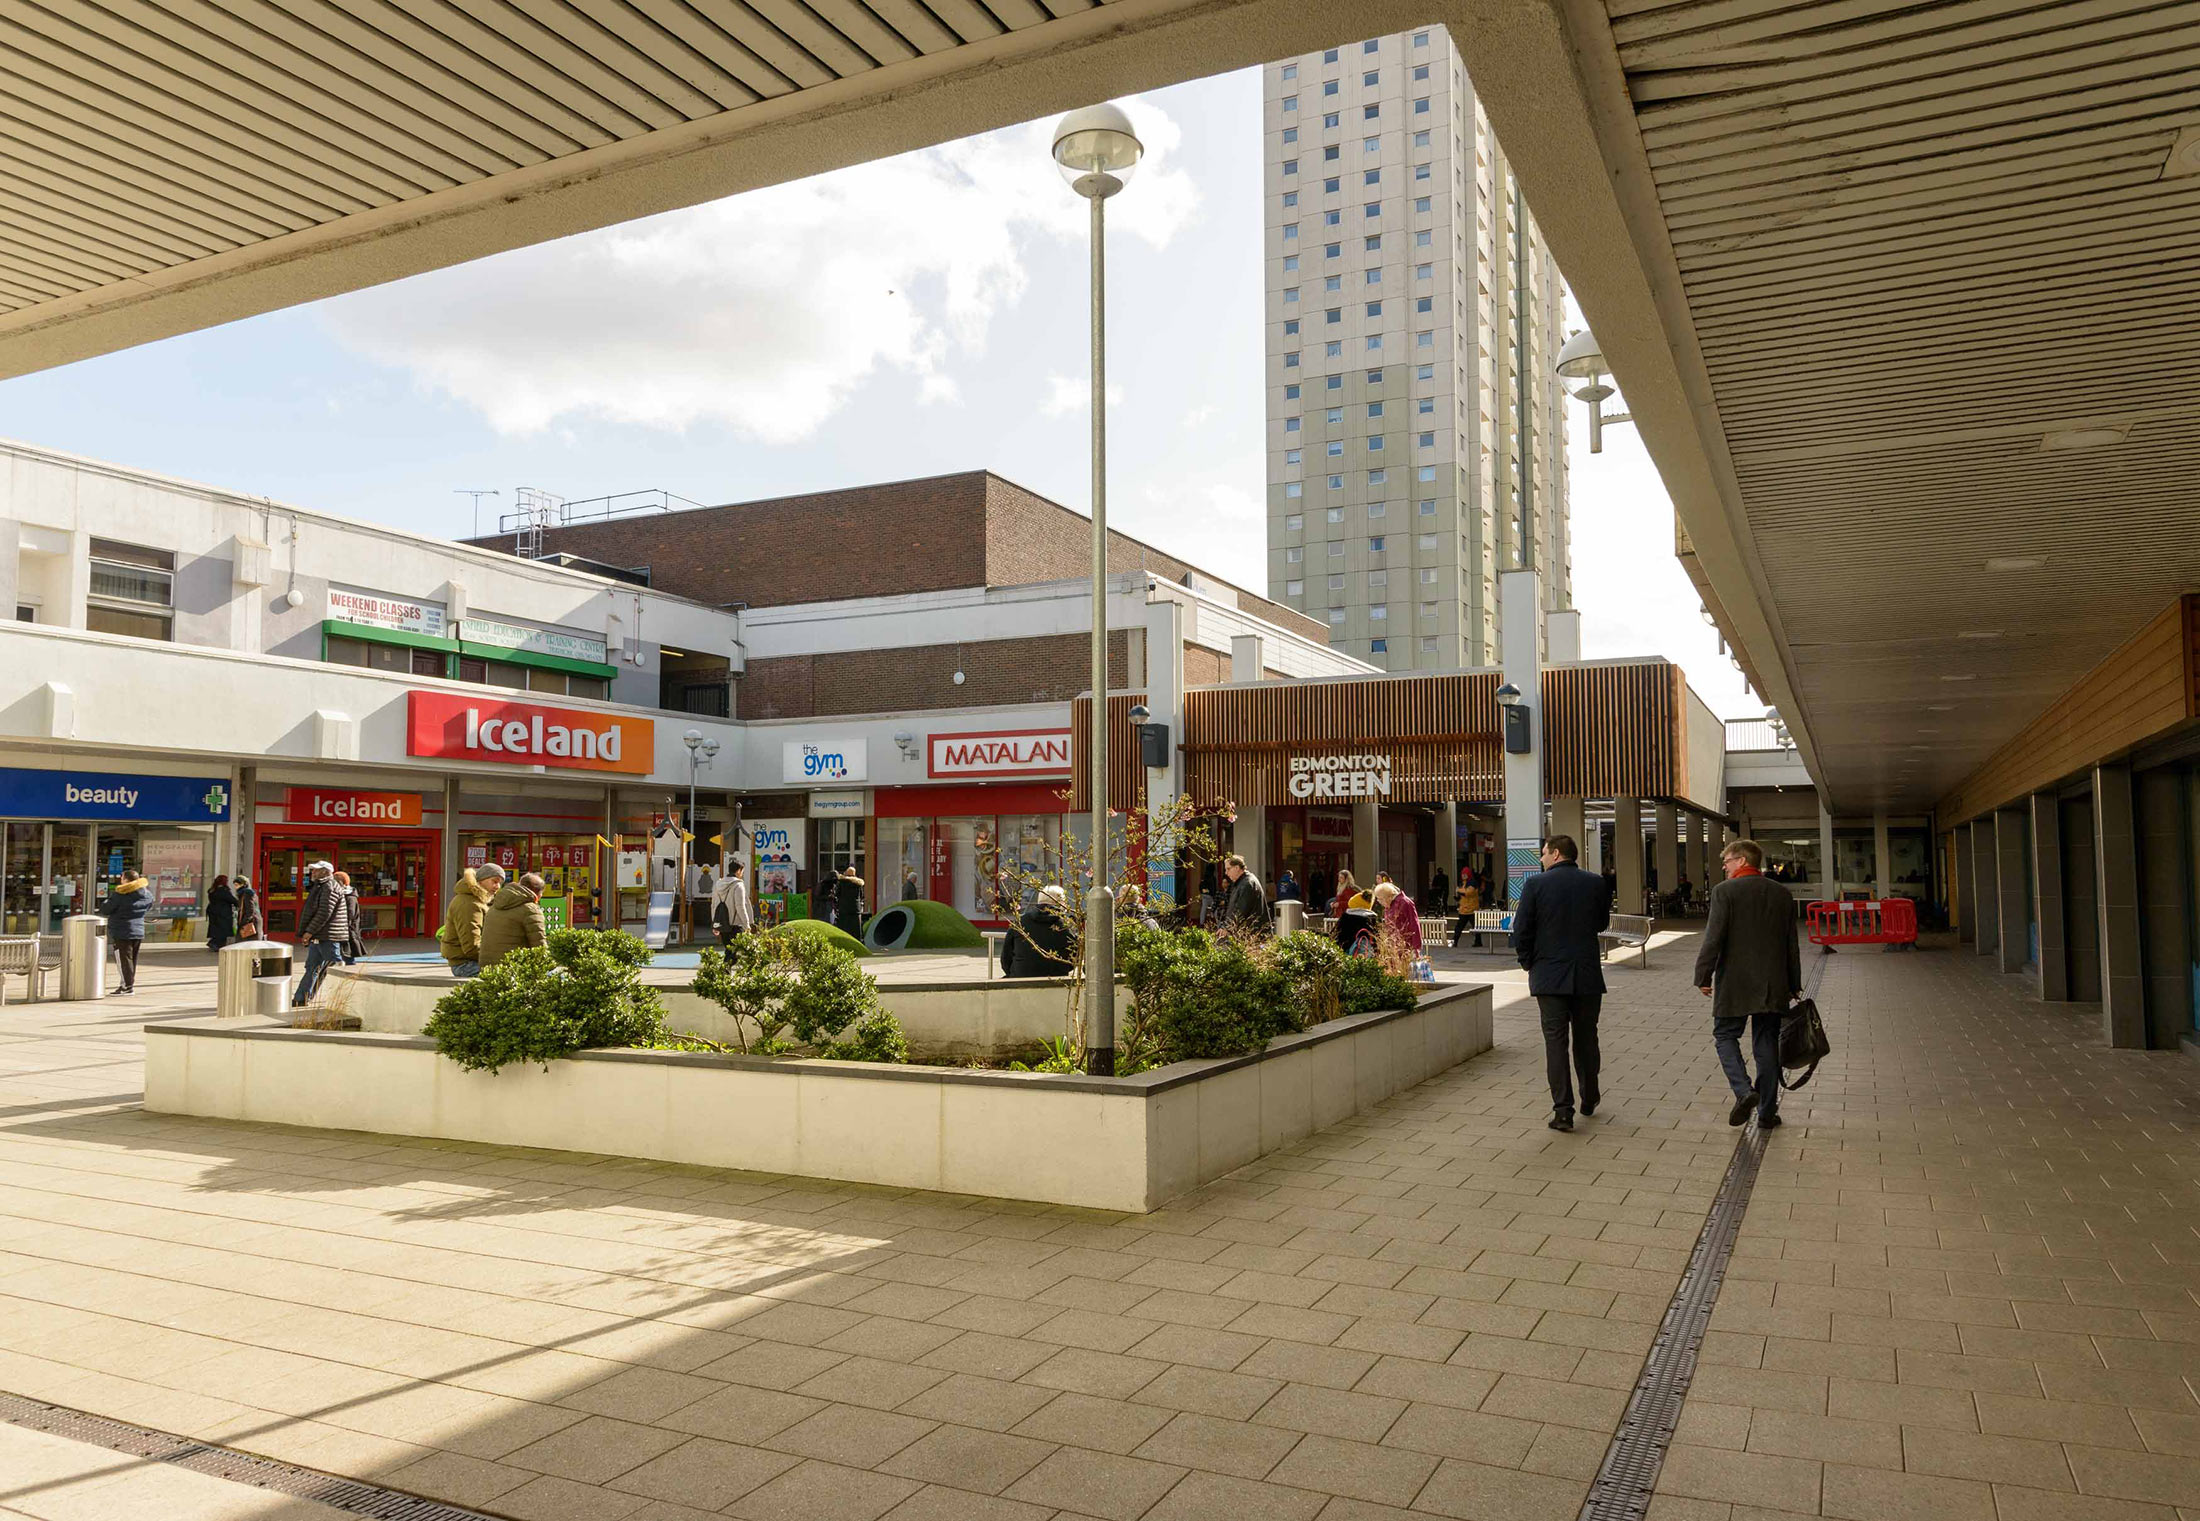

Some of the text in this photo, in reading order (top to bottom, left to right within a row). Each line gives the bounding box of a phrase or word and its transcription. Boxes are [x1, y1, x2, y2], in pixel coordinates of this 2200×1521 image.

[330, 593, 378, 612] WEEKEND
[379, 602, 421, 620] CLASSES
[347, 608, 358, 616] FOR
[358, 610, 380, 620] SCHOOL
[380, 614, 404, 624] CHILDREN
[492, 622, 533, 642] EDUCATION
[545, 633, 577, 649] TRAINING
[579, 639, 605, 655] CENTRE
[465, 708, 621, 761] Iceland
[803, 744, 818, 755] the
[944, 740, 1067, 765] MATALAN
[804, 753, 844, 776] gym
[1290, 754, 1391, 772] EDMONTON
[1288, 771, 1391, 798] GREEN
[65, 783, 139, 808] beauty
[814, 801, 861, 809] thegymgroup.com
[313, 795, 402, 819] Iceland
[753, 821, 767, 831] the
[755, 830, 788, 849] gym
[502, 852, 514, 866] £2
[574, 852, 584, 864] £1
